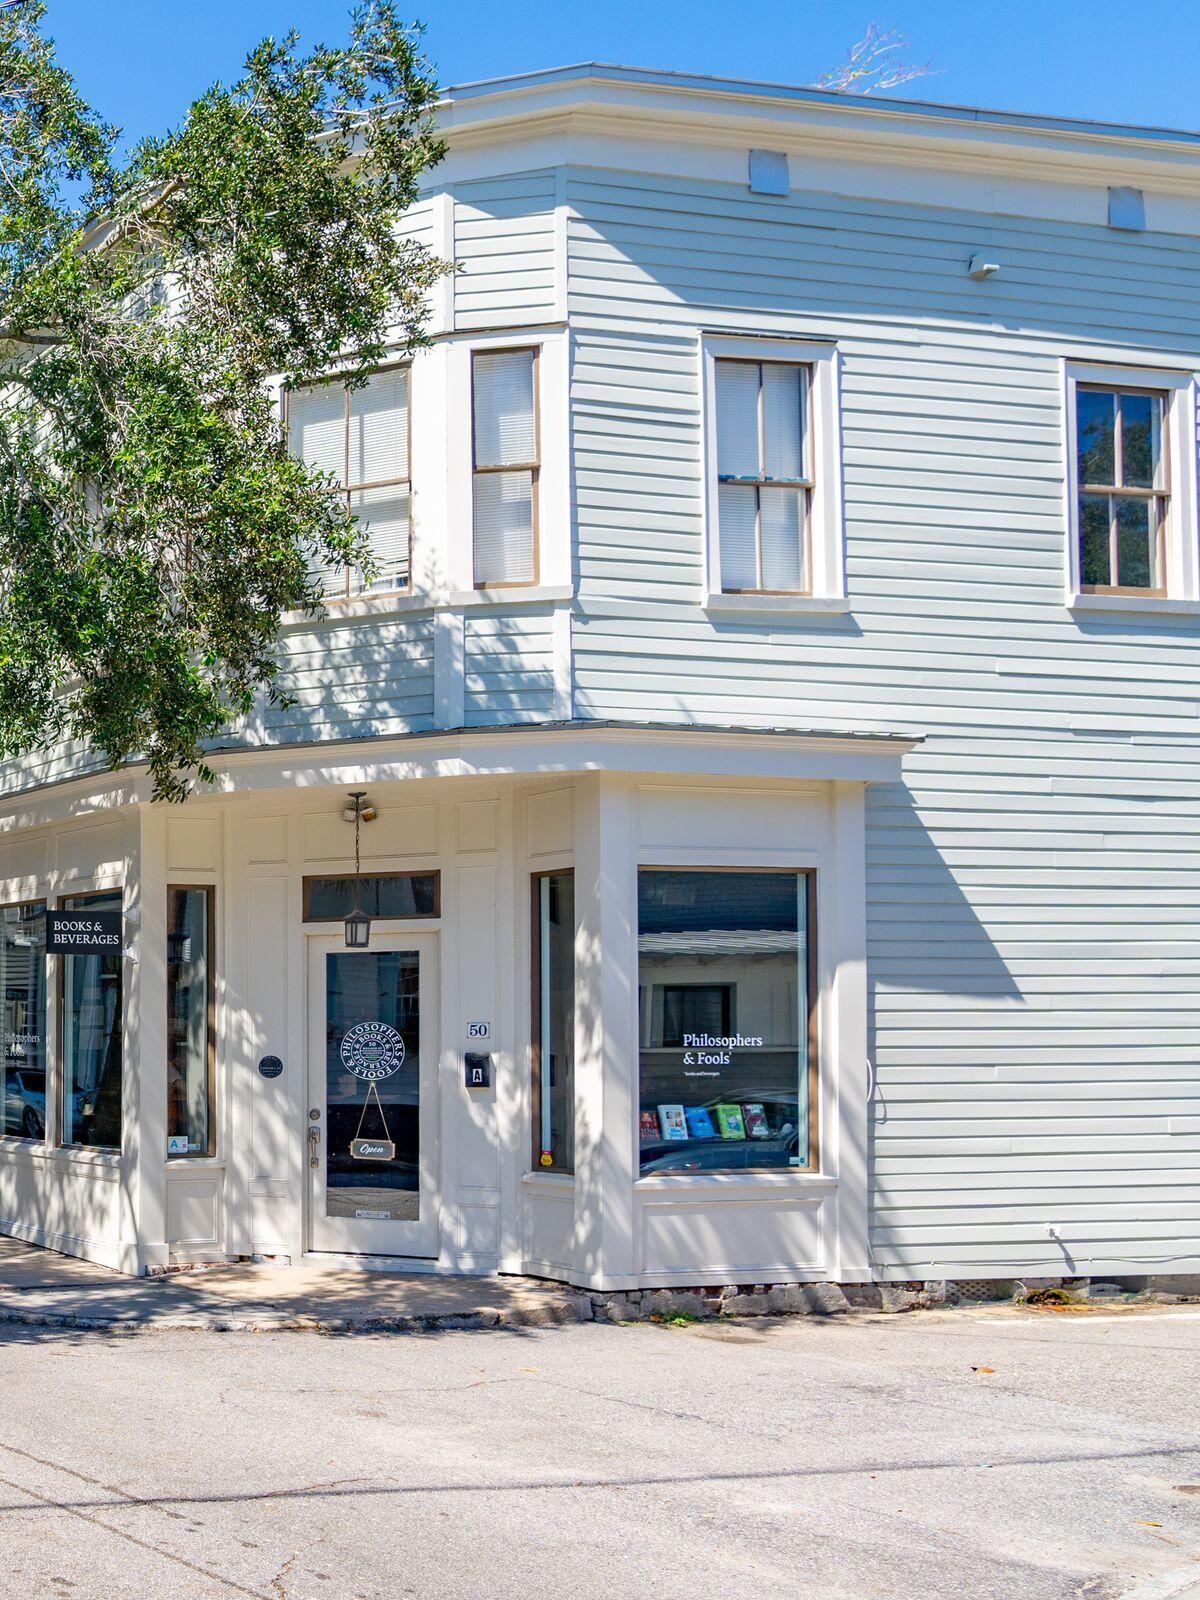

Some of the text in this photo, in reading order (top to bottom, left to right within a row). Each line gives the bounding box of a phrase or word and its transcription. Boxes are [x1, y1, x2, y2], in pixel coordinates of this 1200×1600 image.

[53, 920, 103, 931] BOOKS &
[53, 933, 119, 944] BEVERAGES
[469, 1024, 487, 1036] 50
[342, 1023, 403, 1057] PHILOSOPHERS
[358, 1033, 388, 1043] BOOKS
[682, 1033, 763, 1050] Philosophers
[353, 1050, 392, 1069] BEVERAGES
[683, 1052, 695, 1065] &
[353, 1066, 392, 1079] FOOLS
[474, 1070, 481, 1081] A
[170, 1139, 178, 1148] A
[359, 1143, 385, 1155] Open
